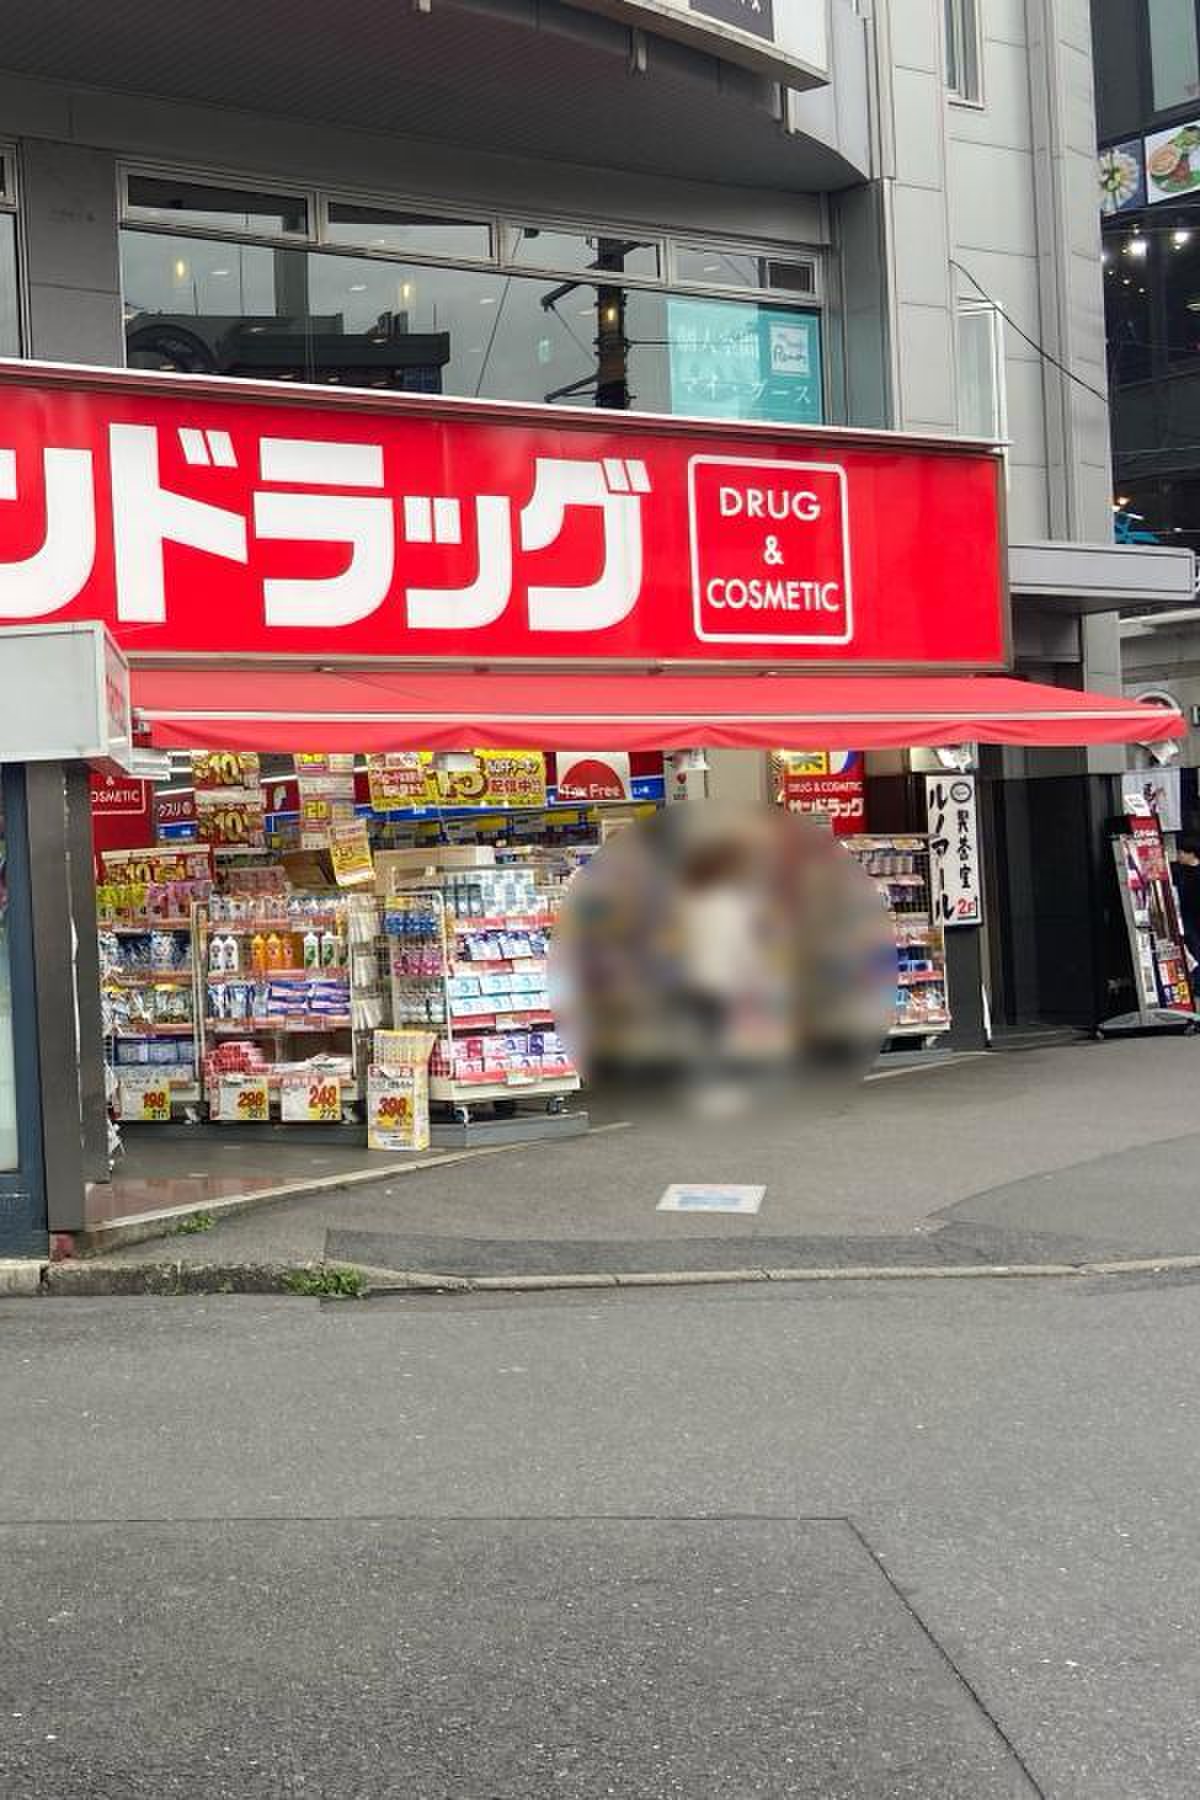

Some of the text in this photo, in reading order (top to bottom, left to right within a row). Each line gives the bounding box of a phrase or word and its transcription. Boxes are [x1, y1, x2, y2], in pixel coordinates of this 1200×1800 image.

[719, 486, 822, 521] DRUG
[763, 534, 785, 566] &
[706, 577, 841, 613] COSMETIC
